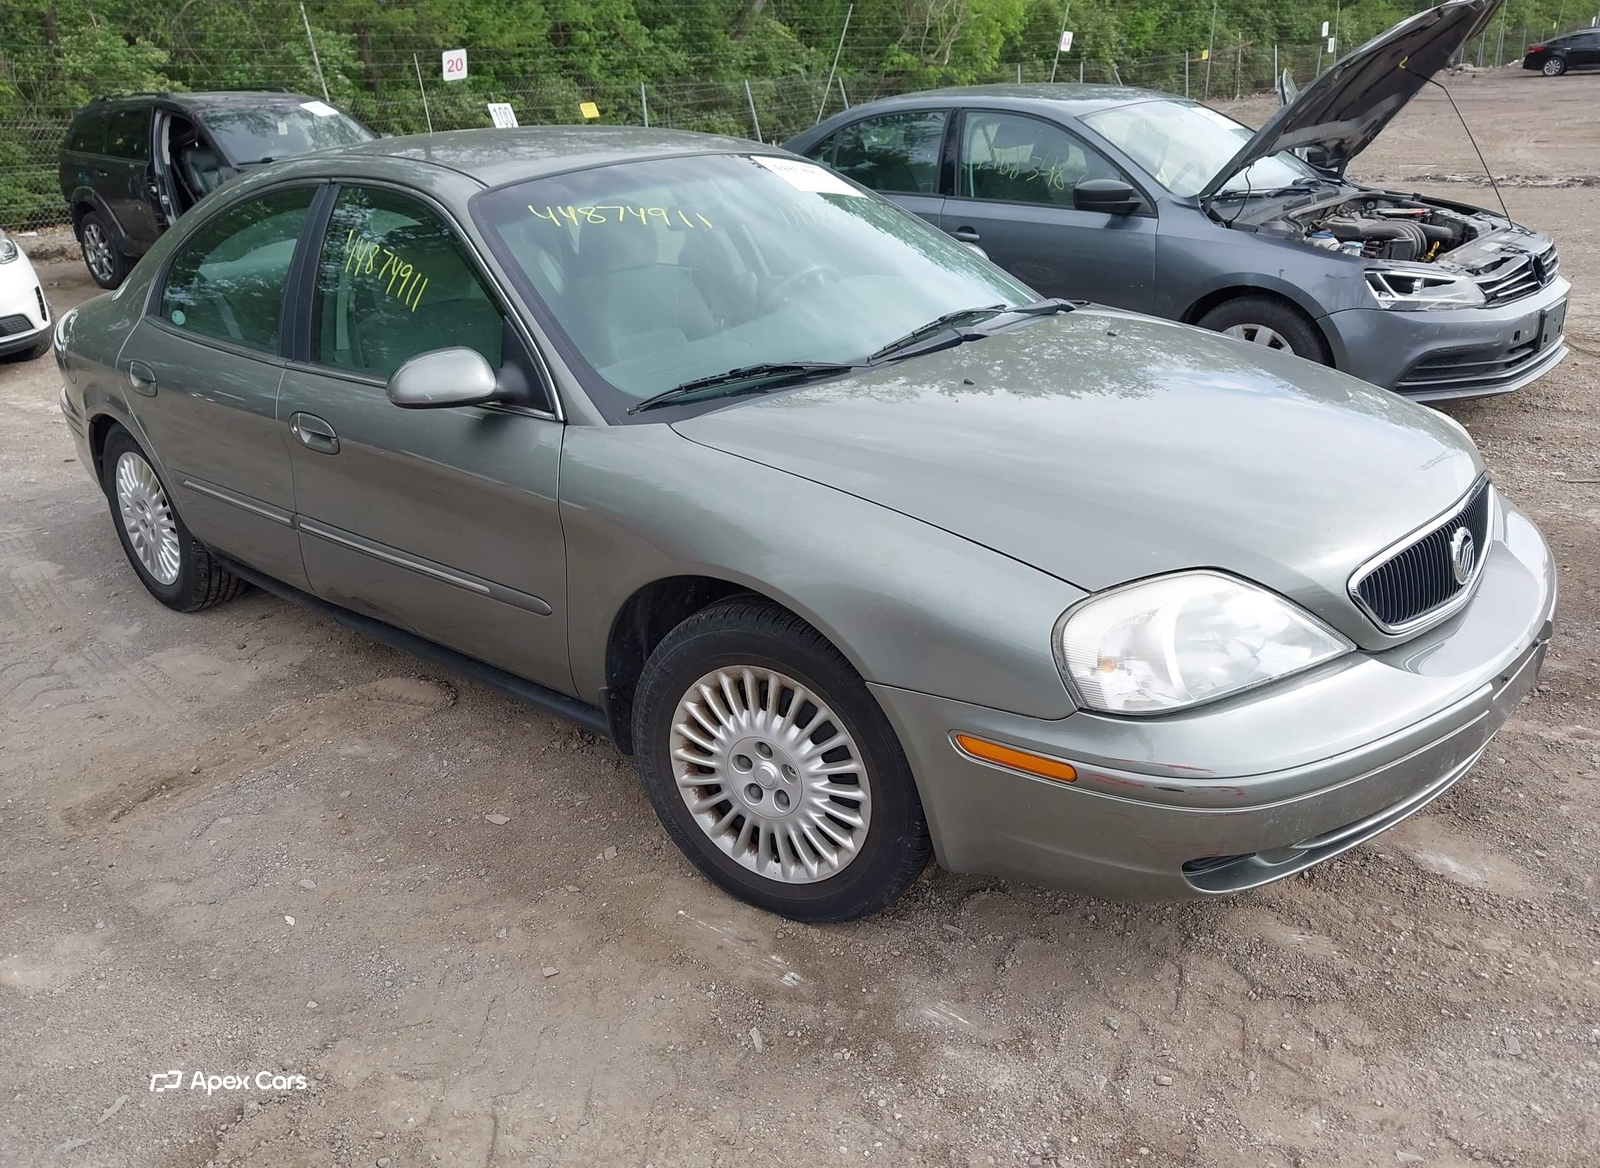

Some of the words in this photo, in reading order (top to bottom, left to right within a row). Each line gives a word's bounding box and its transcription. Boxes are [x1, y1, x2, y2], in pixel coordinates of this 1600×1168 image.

[447, 57, 464, 73] 20
[492, 105, 514, 127] 100
[528, 204, 714, 230] 44874911
[344, 229, 429, 313] 44874911
